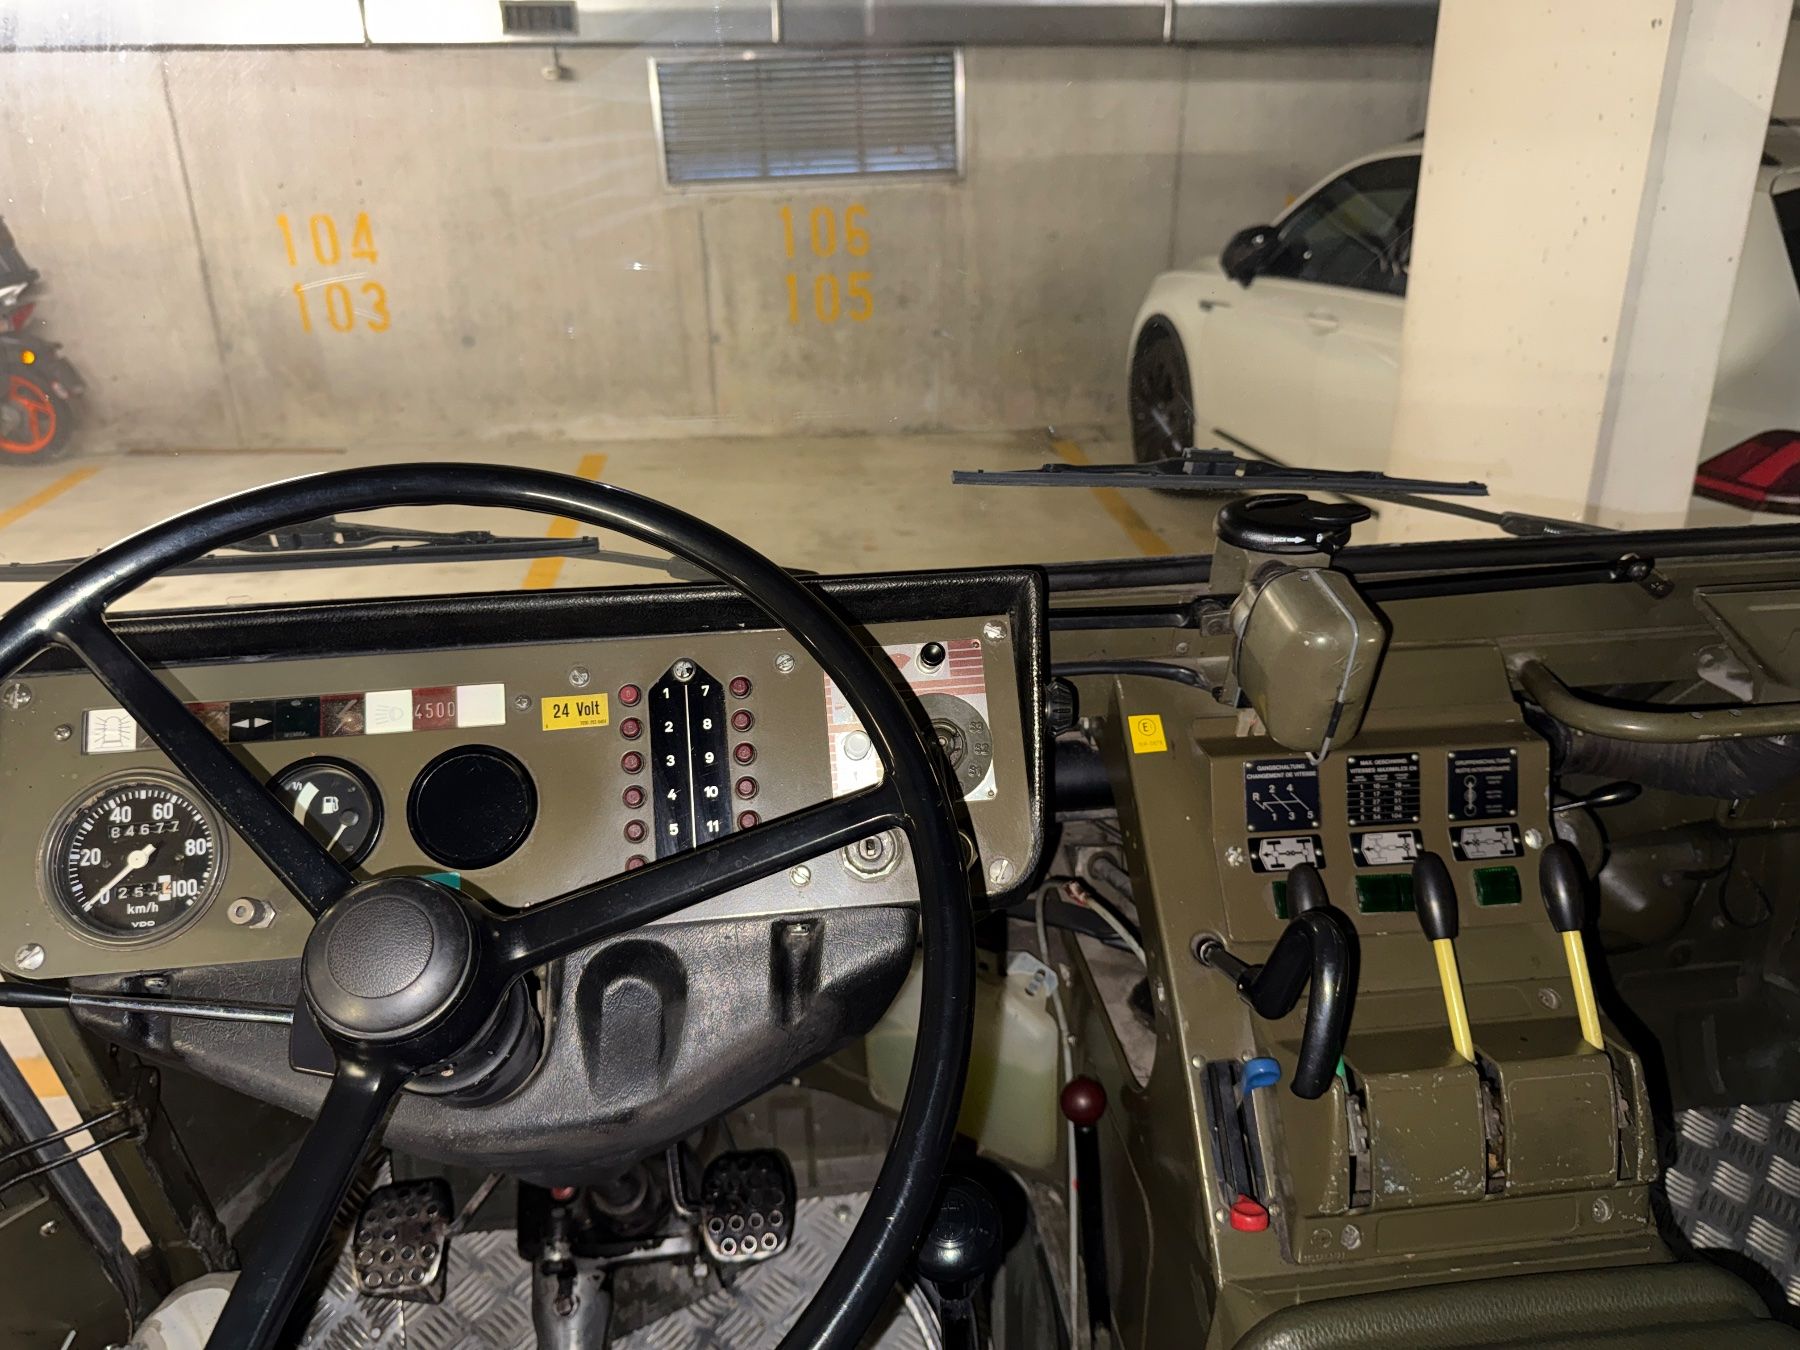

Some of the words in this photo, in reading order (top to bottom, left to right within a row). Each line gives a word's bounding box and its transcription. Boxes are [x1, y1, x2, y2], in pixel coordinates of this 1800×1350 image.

[779, 204, 872, 258] 106
[277, 212, 379, 267] 104
[783, 272, 875, 325] 105
[292, 281, 392, 333] 103
[663, 688, 670, 699] 1
[701, 685, 710, 696] 7
[414, 701, 456, 719] 4500
[553, 703, 570, 719] 24
[576, 700, 600, 716] Volt
[664, 721, 674, 733] 2
[702, 718, 713, 730] 8
[666, 755, 676, 767] 3
[704, 752, 715, 764] 9
[667, 788, 677, 800] 4
[704, 785, 719, 798] 10
[1269, 784, 1276, 793] 2
[1286, 783, 1294, 792] 4
[1252, 792, 1260, 801] R
[109, 805, 132, 823] 40
[152, 802, 174, 820] 60
[1271, 812, 1277, 821] 1
[1288, 811, 1296, 820] 3
[1307, 810, 1314, 819] 5
[111, 821, 179, 839] 84677
[669, 823, 679, 836] 5
[706, 820, 720, 833] 11
[185, 838, 207, 856] 80
[80, 848, 101, 866] 20
[172, 879, 198, 898] 100
[127, 902, 159, 915] km/h
[131, 920, 155, 928] VDO
